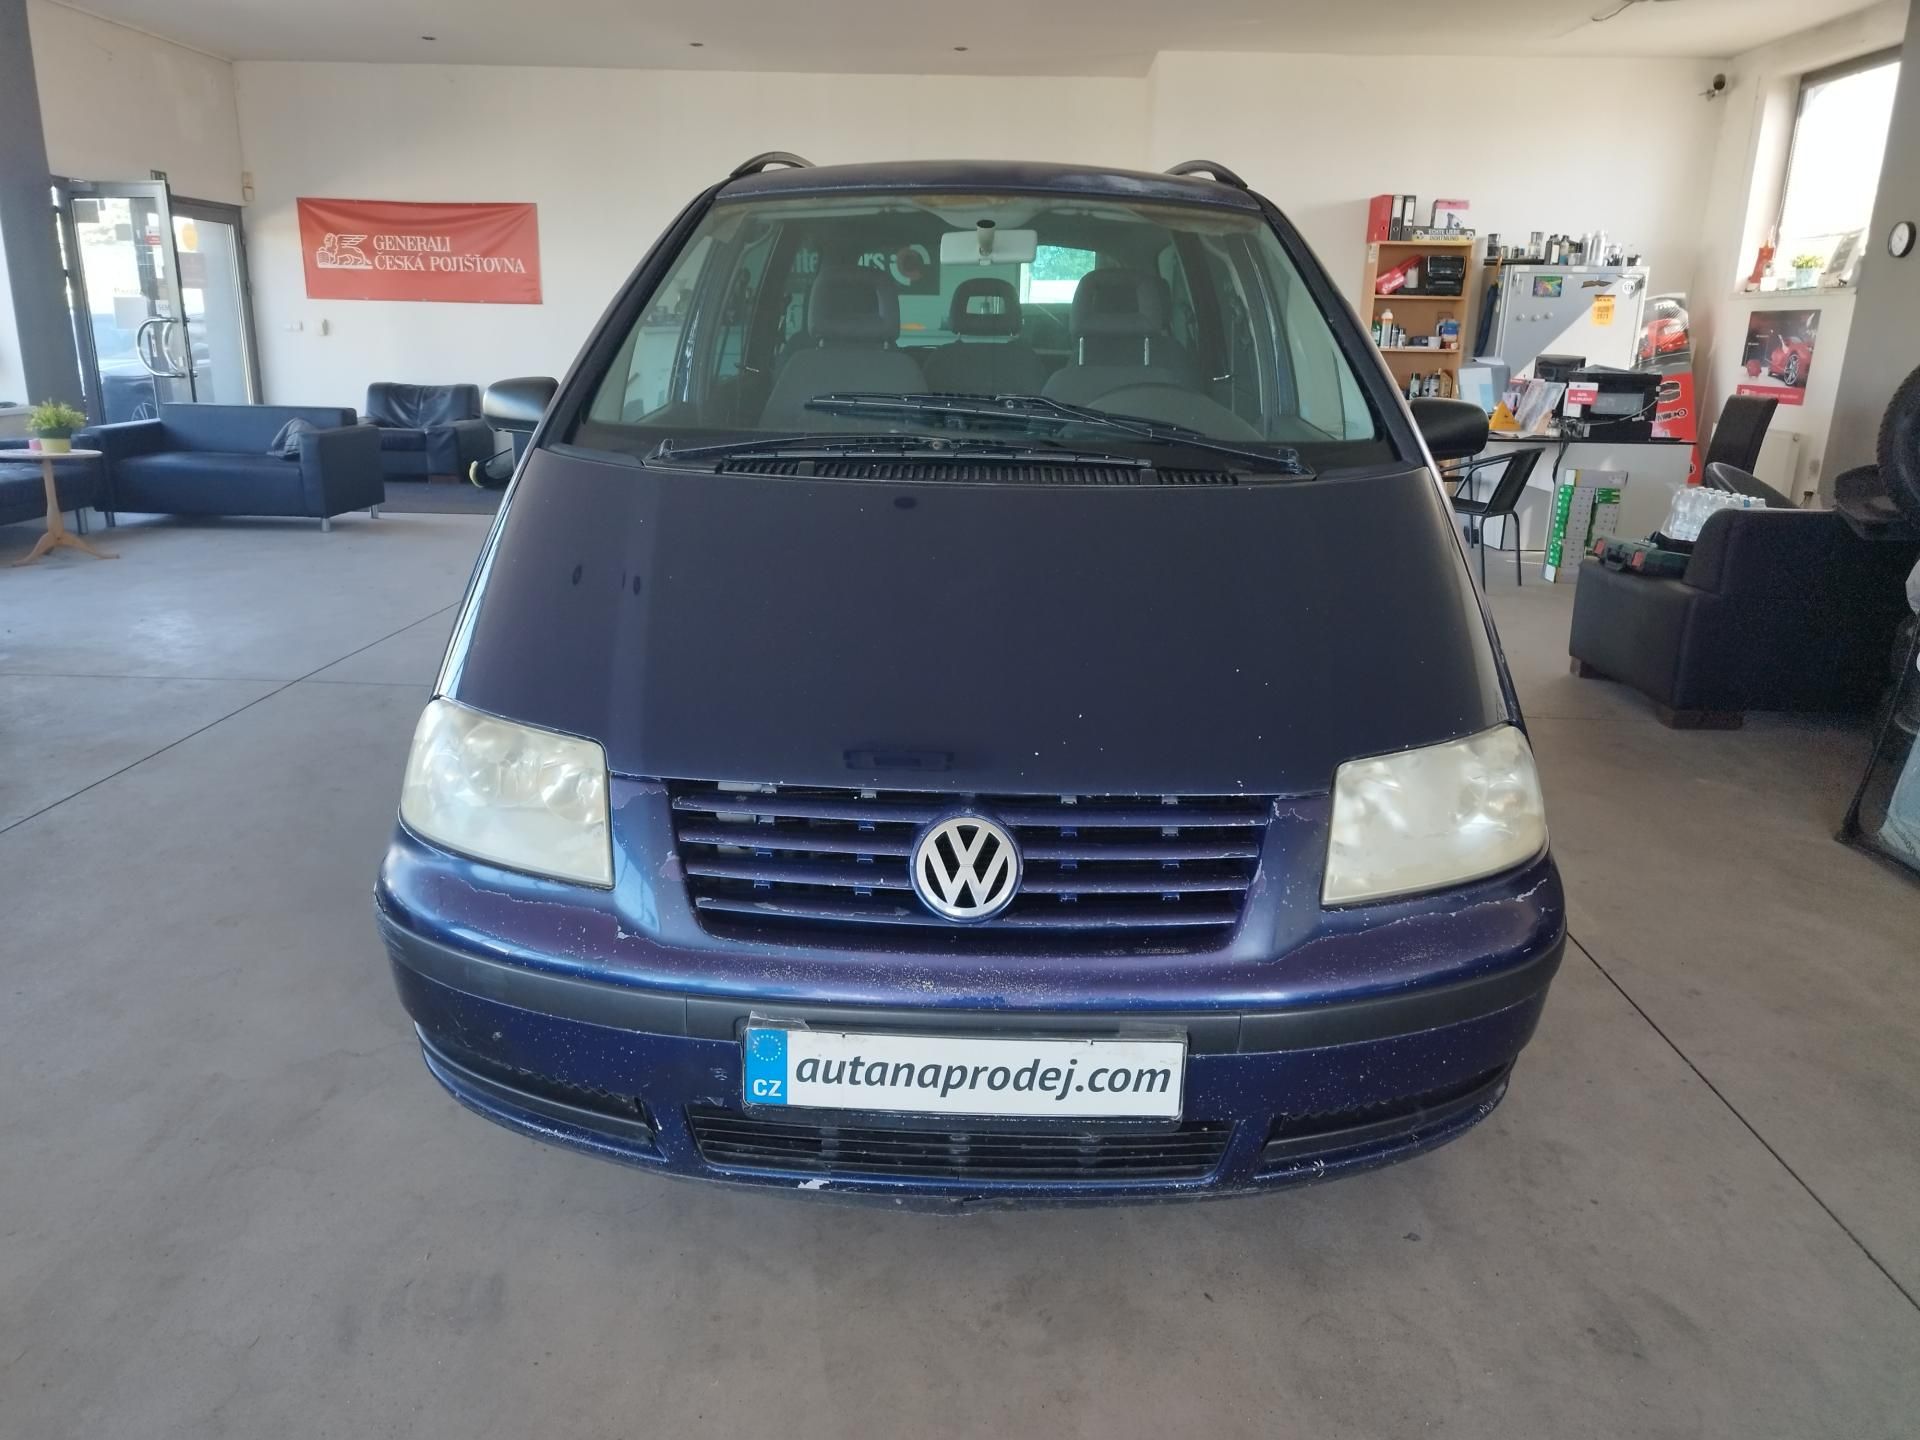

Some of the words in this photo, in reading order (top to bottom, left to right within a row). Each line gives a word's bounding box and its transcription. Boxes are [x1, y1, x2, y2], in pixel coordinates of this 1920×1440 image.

[373, 235, 451, 252] GENERALI
[374, 250, 425, 271] ČESKÁ
[430, 253, 527, 274] POJIŠŤOVNA
[752, 1078, 782, 1097] CZ
[795, 1055, 1172, 1100] autanaprodej.com
